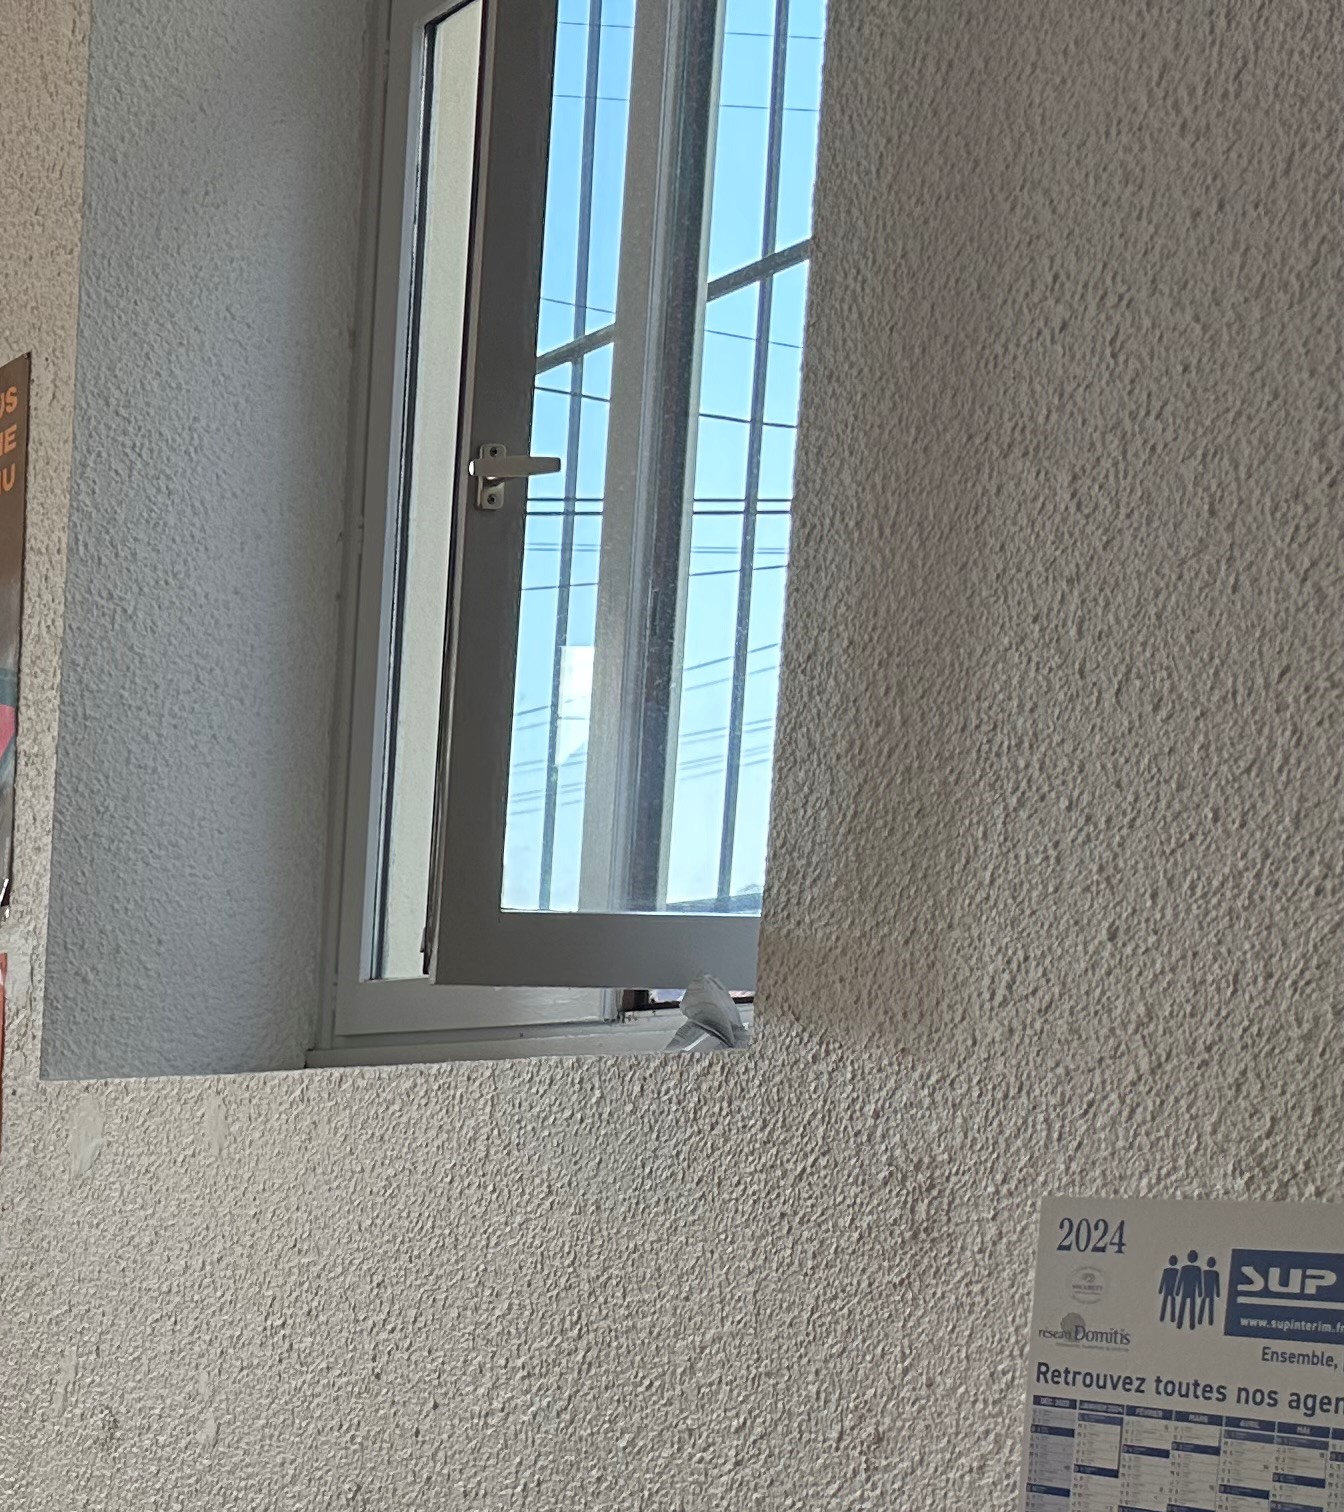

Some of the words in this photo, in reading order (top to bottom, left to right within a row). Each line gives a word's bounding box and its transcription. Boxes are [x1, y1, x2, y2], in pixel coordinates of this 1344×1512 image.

[1056, 1217, 1127, 1254] 2024
[1237, 1265, 1337, 1295] SUP
[1074, 1325, 1131, 1346] Domitis
[1261, 1346, 1338, 1369] Ensemble,
[1035, 1361, 1147, 1395] Retrouvez
[1154, 1374, 1227, 1404] toutes
[1235, 1383, 1278, 1408] nos
